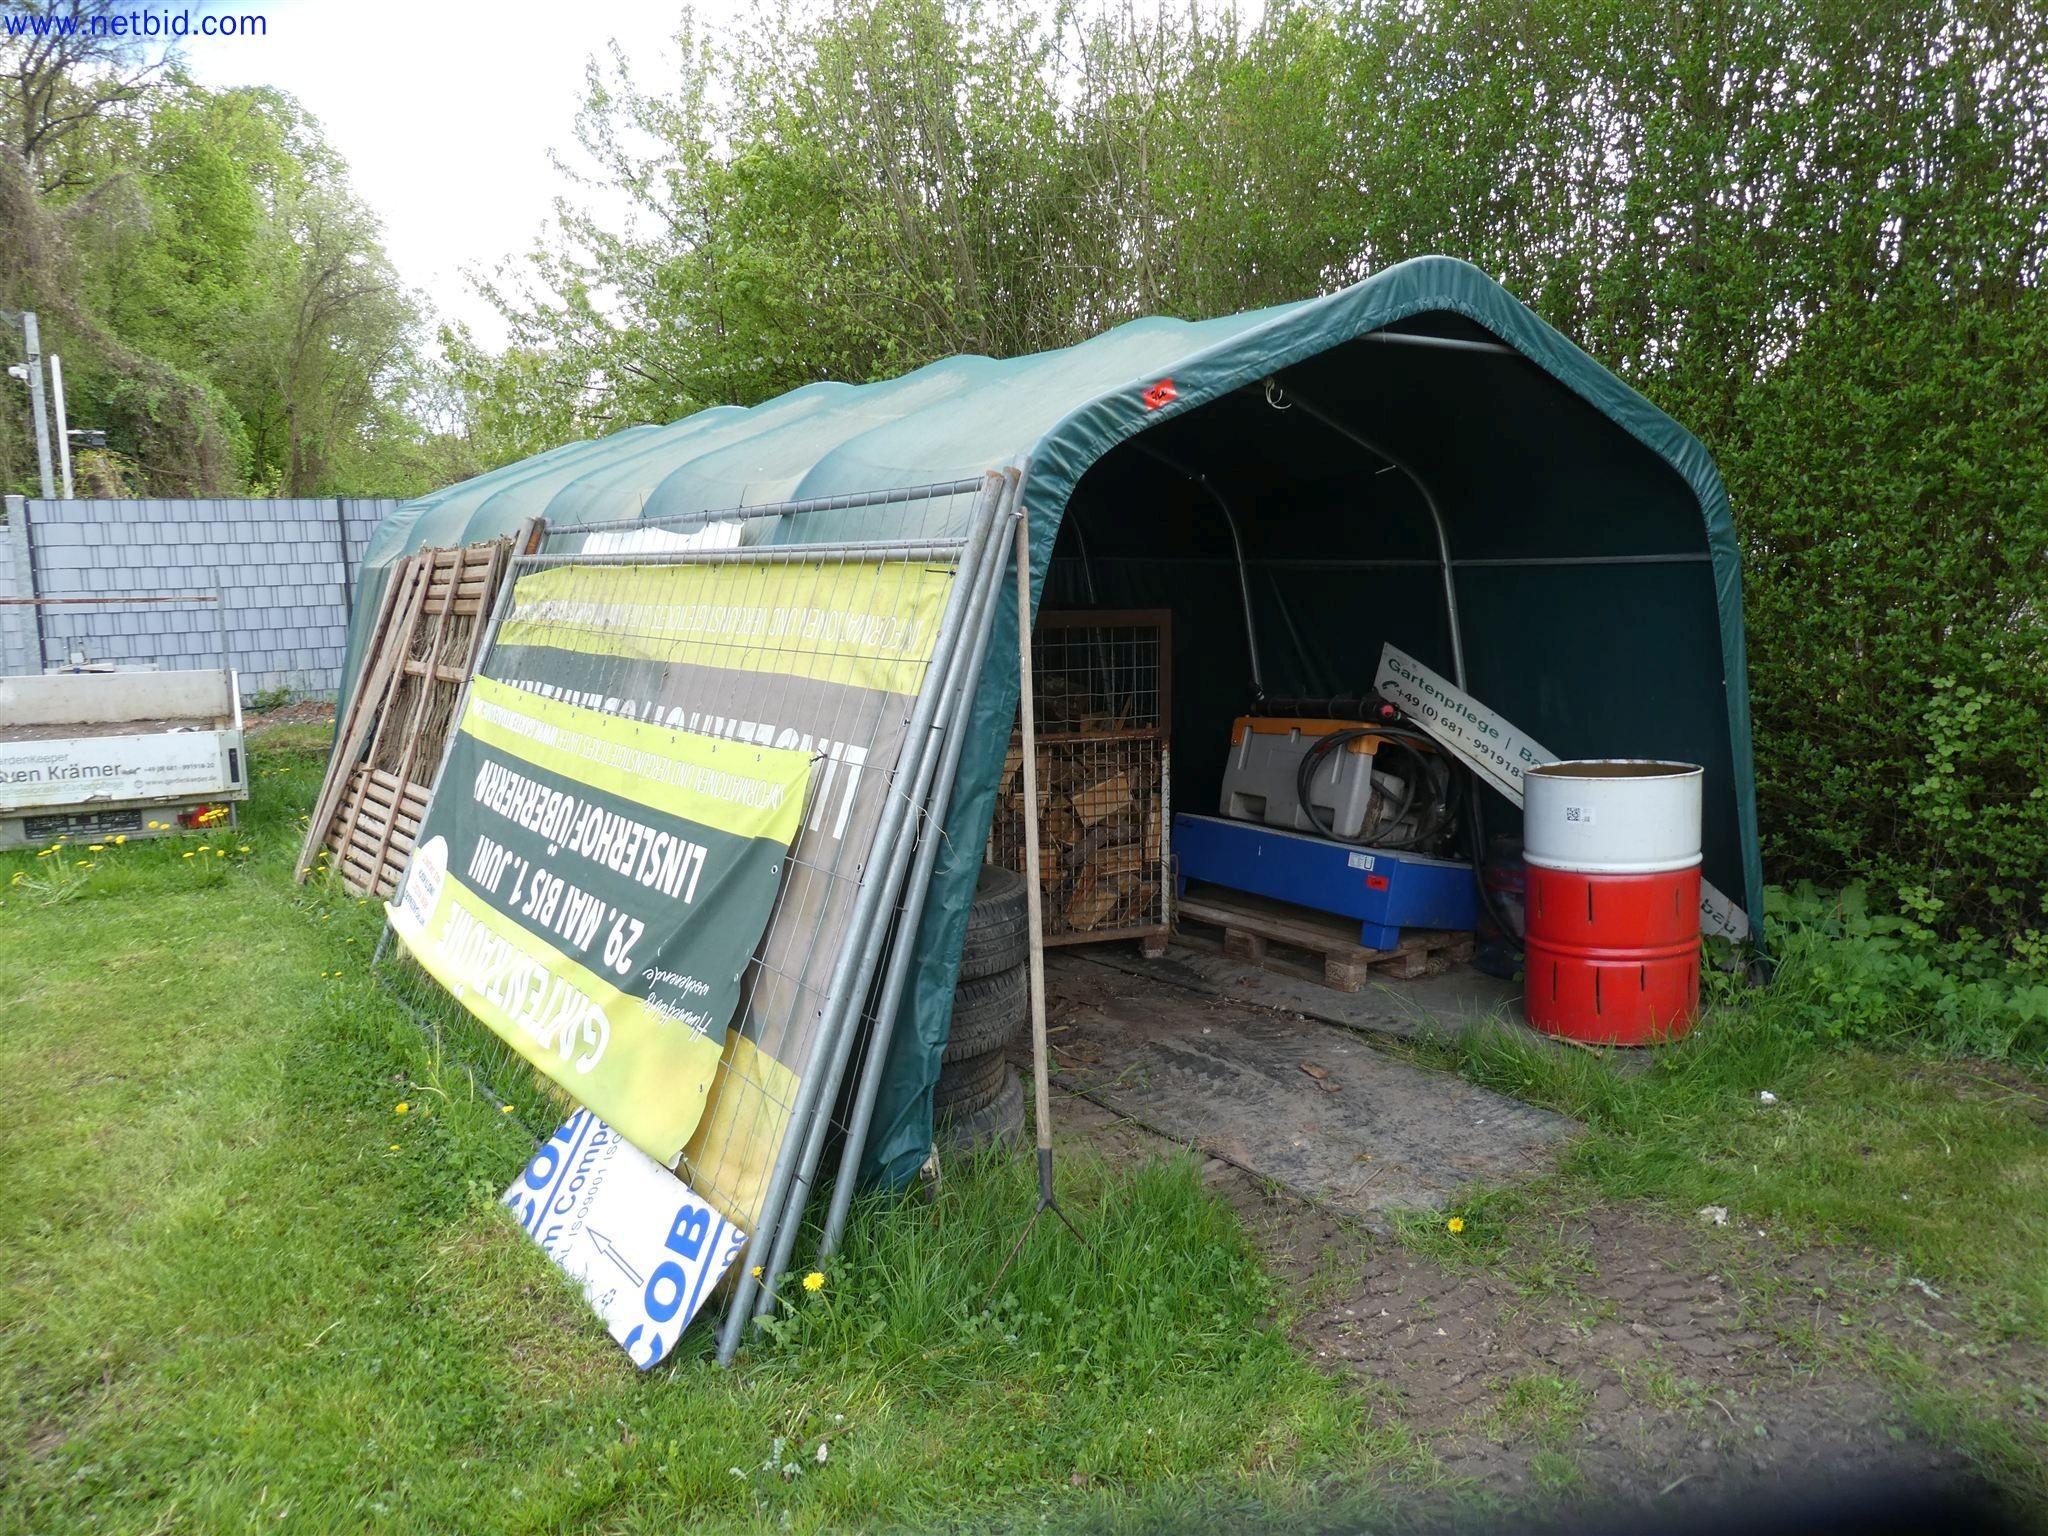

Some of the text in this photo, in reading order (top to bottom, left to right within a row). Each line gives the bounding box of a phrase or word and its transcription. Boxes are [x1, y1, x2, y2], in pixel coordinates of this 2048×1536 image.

[769, 607, 798, 636] UND
[800, 607, 923, 651] INFORMATIONEN
[1388, 658, 1499, 739] Gartenpflege
[1519, 747, 1542, 767] Ba
[1396, 688, 1420, 707] +49
[1421, 703, 1439, 721] (0)
[1440, 717, 1463, 737] 681
[1473, 738, 1524, 779] 991918-
[48, 763, 122, 780] Krämer
[671, 761, 696, 788] UND
[695, 767, 786, 810] INFORMATIONEN
[474, 760, 708, 904] LINSLERHOF/ÜBERHERRN
[467, 834, 513, 893] JUNI
[508, 857, 530, 905] 1.
[522, 868, 565, 927] BIS
[554, 885, 607, 952] MAI
[1701, 898, 1737, 935] bau
[603, 908, 645, 975] 29.
[642, 966, 709, 999] wochenende
[568, 1168, 607, 1237] ISO9001
[603, 1133, 624, 1161] ISO
[623, 1203, 712, 1371] COB
